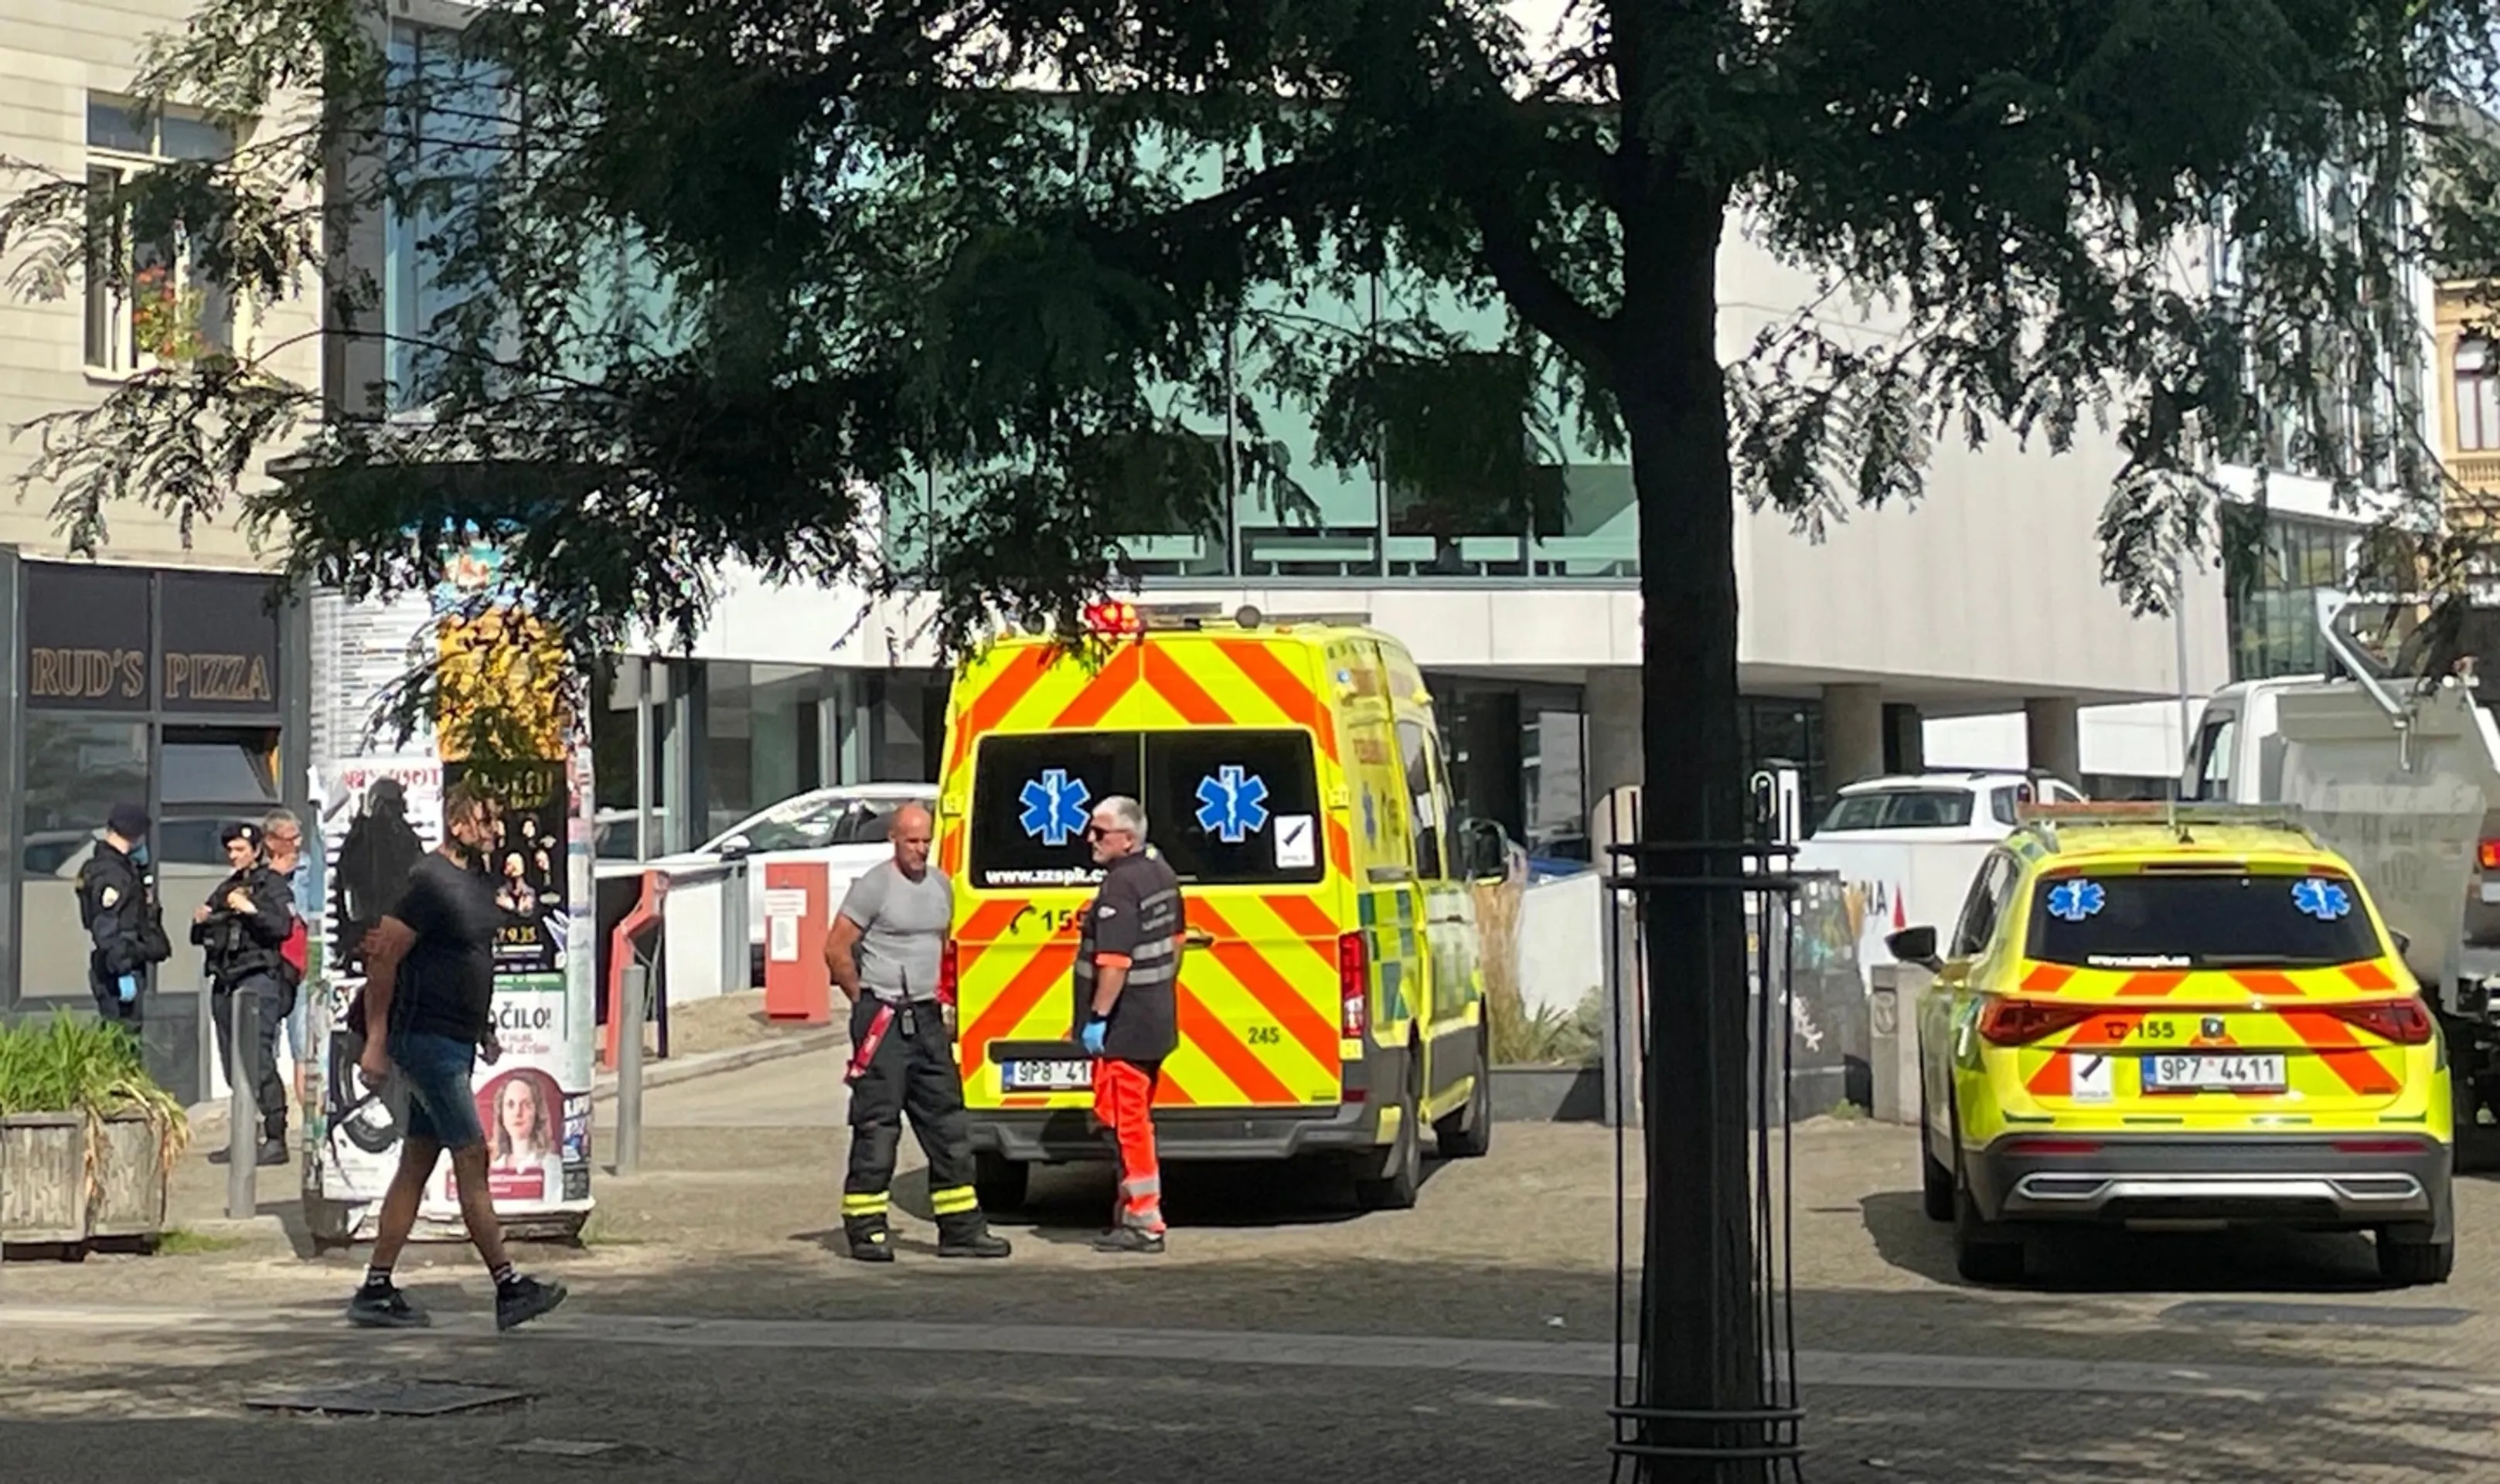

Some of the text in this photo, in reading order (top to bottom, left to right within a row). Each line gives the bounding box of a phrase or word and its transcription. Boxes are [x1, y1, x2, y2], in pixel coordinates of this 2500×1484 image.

[32, 648, 271, 701] RUD'S PIZZA
[985, 866, 1107, 886] www.zzspk.c
[1248, 1026, 1280, 1045] 245
[2138, 1021, 2175, 1039] 155
[1019, 1060, 1088, 1082] 9P8 41
[2161, 1057, 2275, 1081] 9P7 4411
